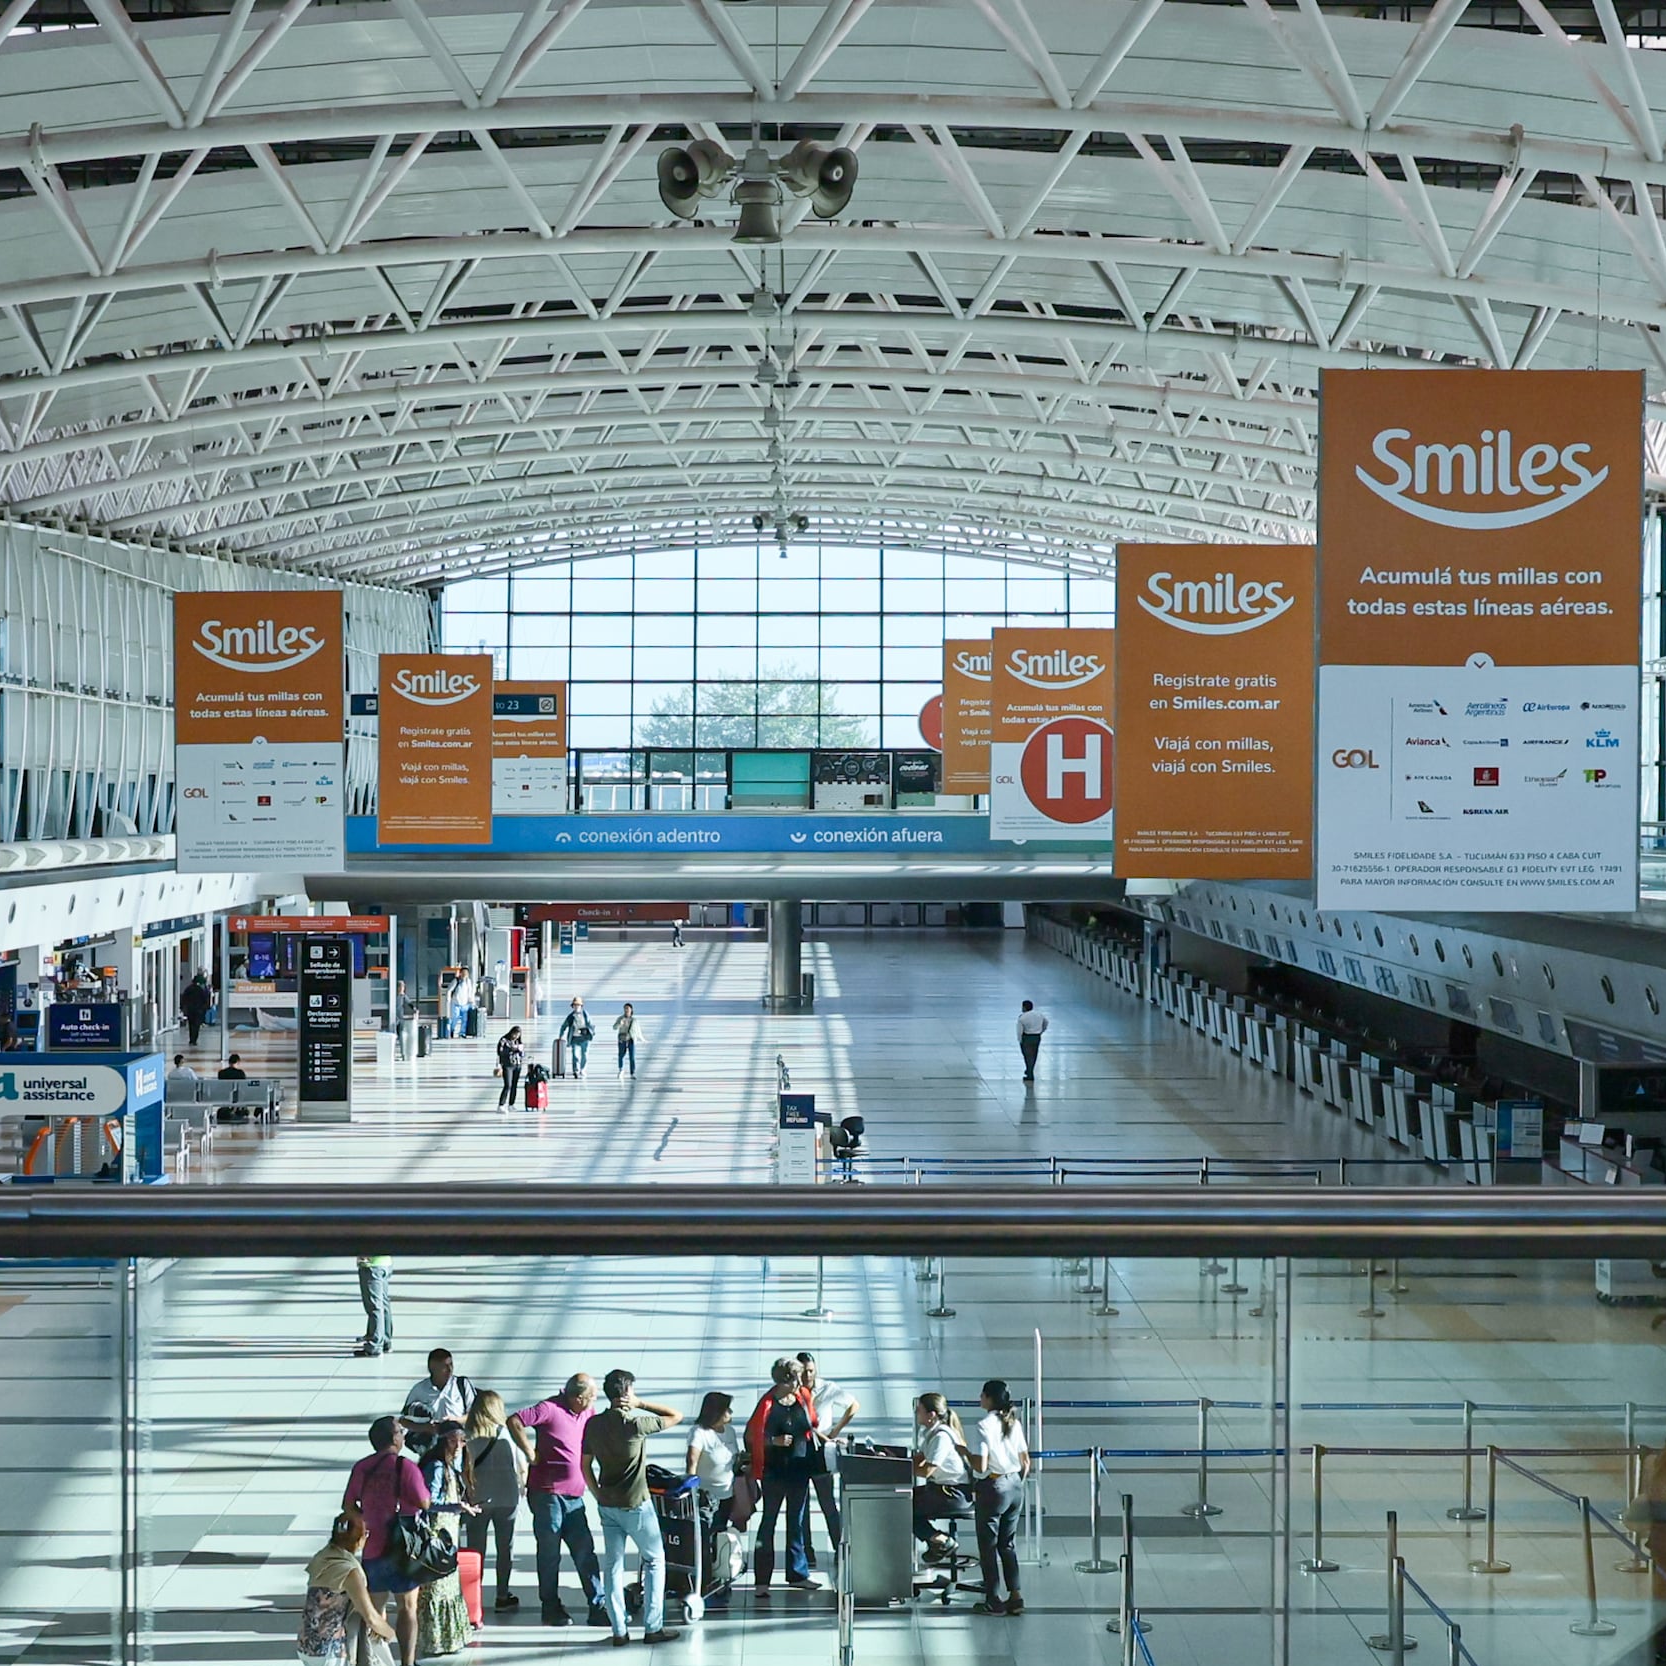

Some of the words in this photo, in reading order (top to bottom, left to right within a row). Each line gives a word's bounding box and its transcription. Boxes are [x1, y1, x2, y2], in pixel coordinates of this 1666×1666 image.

[1371, 427, 1592, 499] Smiles
[1359, 566, 1452, 585] Acumulá
[1458, 569, 1491, 585] tus
[1497, 567, 1558, 585] millas
[1564, 570, 1602, 585] con
[1146, 571, 1284, 617] Smiles
[1346, 598, 1406, 616] todas
[1412, 600, 1467, 616] estas
[1473, 597, 1534, 616] líneas
[1539, 597, 1614, 616] aéreas.
[199, 619, 317, 658] Smiles
[1011, 649, 1098, 678] Smiles
[396, 669, 475, 694] Smiles
[1153, 672, 1231, 692] Registrate
[1234, 673, 1277, 691] gratis
[196, 690, 244, 703] Acumulá
[247, 693, 265, 702] tus
[267, 691, 300, 702] millas
[303, 693, 322, 702] con
[1150, 697, 1167, 710] en
[1173, 696, 1280, 710] Smiles.com.ar
[190, 708, 220, 719] todas
[223, 709, 253, 719] estas
[1002, 716, 1026, 724] todas
[400, 727, 444, 736] Registrate
[446, 726, 471, 736] gratis
[411, 740, 473, 748] Smiles.com.ar
[1154, 736, 1191, 754] Viajá
[1195, 739, 1222, 751] con
[1226, 736, 1274, 754] millas,
[1406, 737, 1440, 747] Avianca
[1586, 739, 1619, 748] KLM
[1047, 734, 1101, 799] H
[1333, 749, 1379, 769] GOL
[401, 763, 422, 772] Viajá
[1152, 759, 1185, 777] viajá
[1190, 762, 1217, 773] con
[1222, 759, 1276, 774] Smiles.
[183, 788, 209, 798] GOL
[579, 826, 653, 844] conexión
[656, 827, 721, 844] adentro
[813, 826, 888, 844] conexión
[891, 826, 943, 843] afuera
[577, 908, 611, 916] Check-in
[23, 1077, 87, 1089] universal
[23, 1090, 95, 1101] assistance
[669, 1534, 680, 1546] LG
